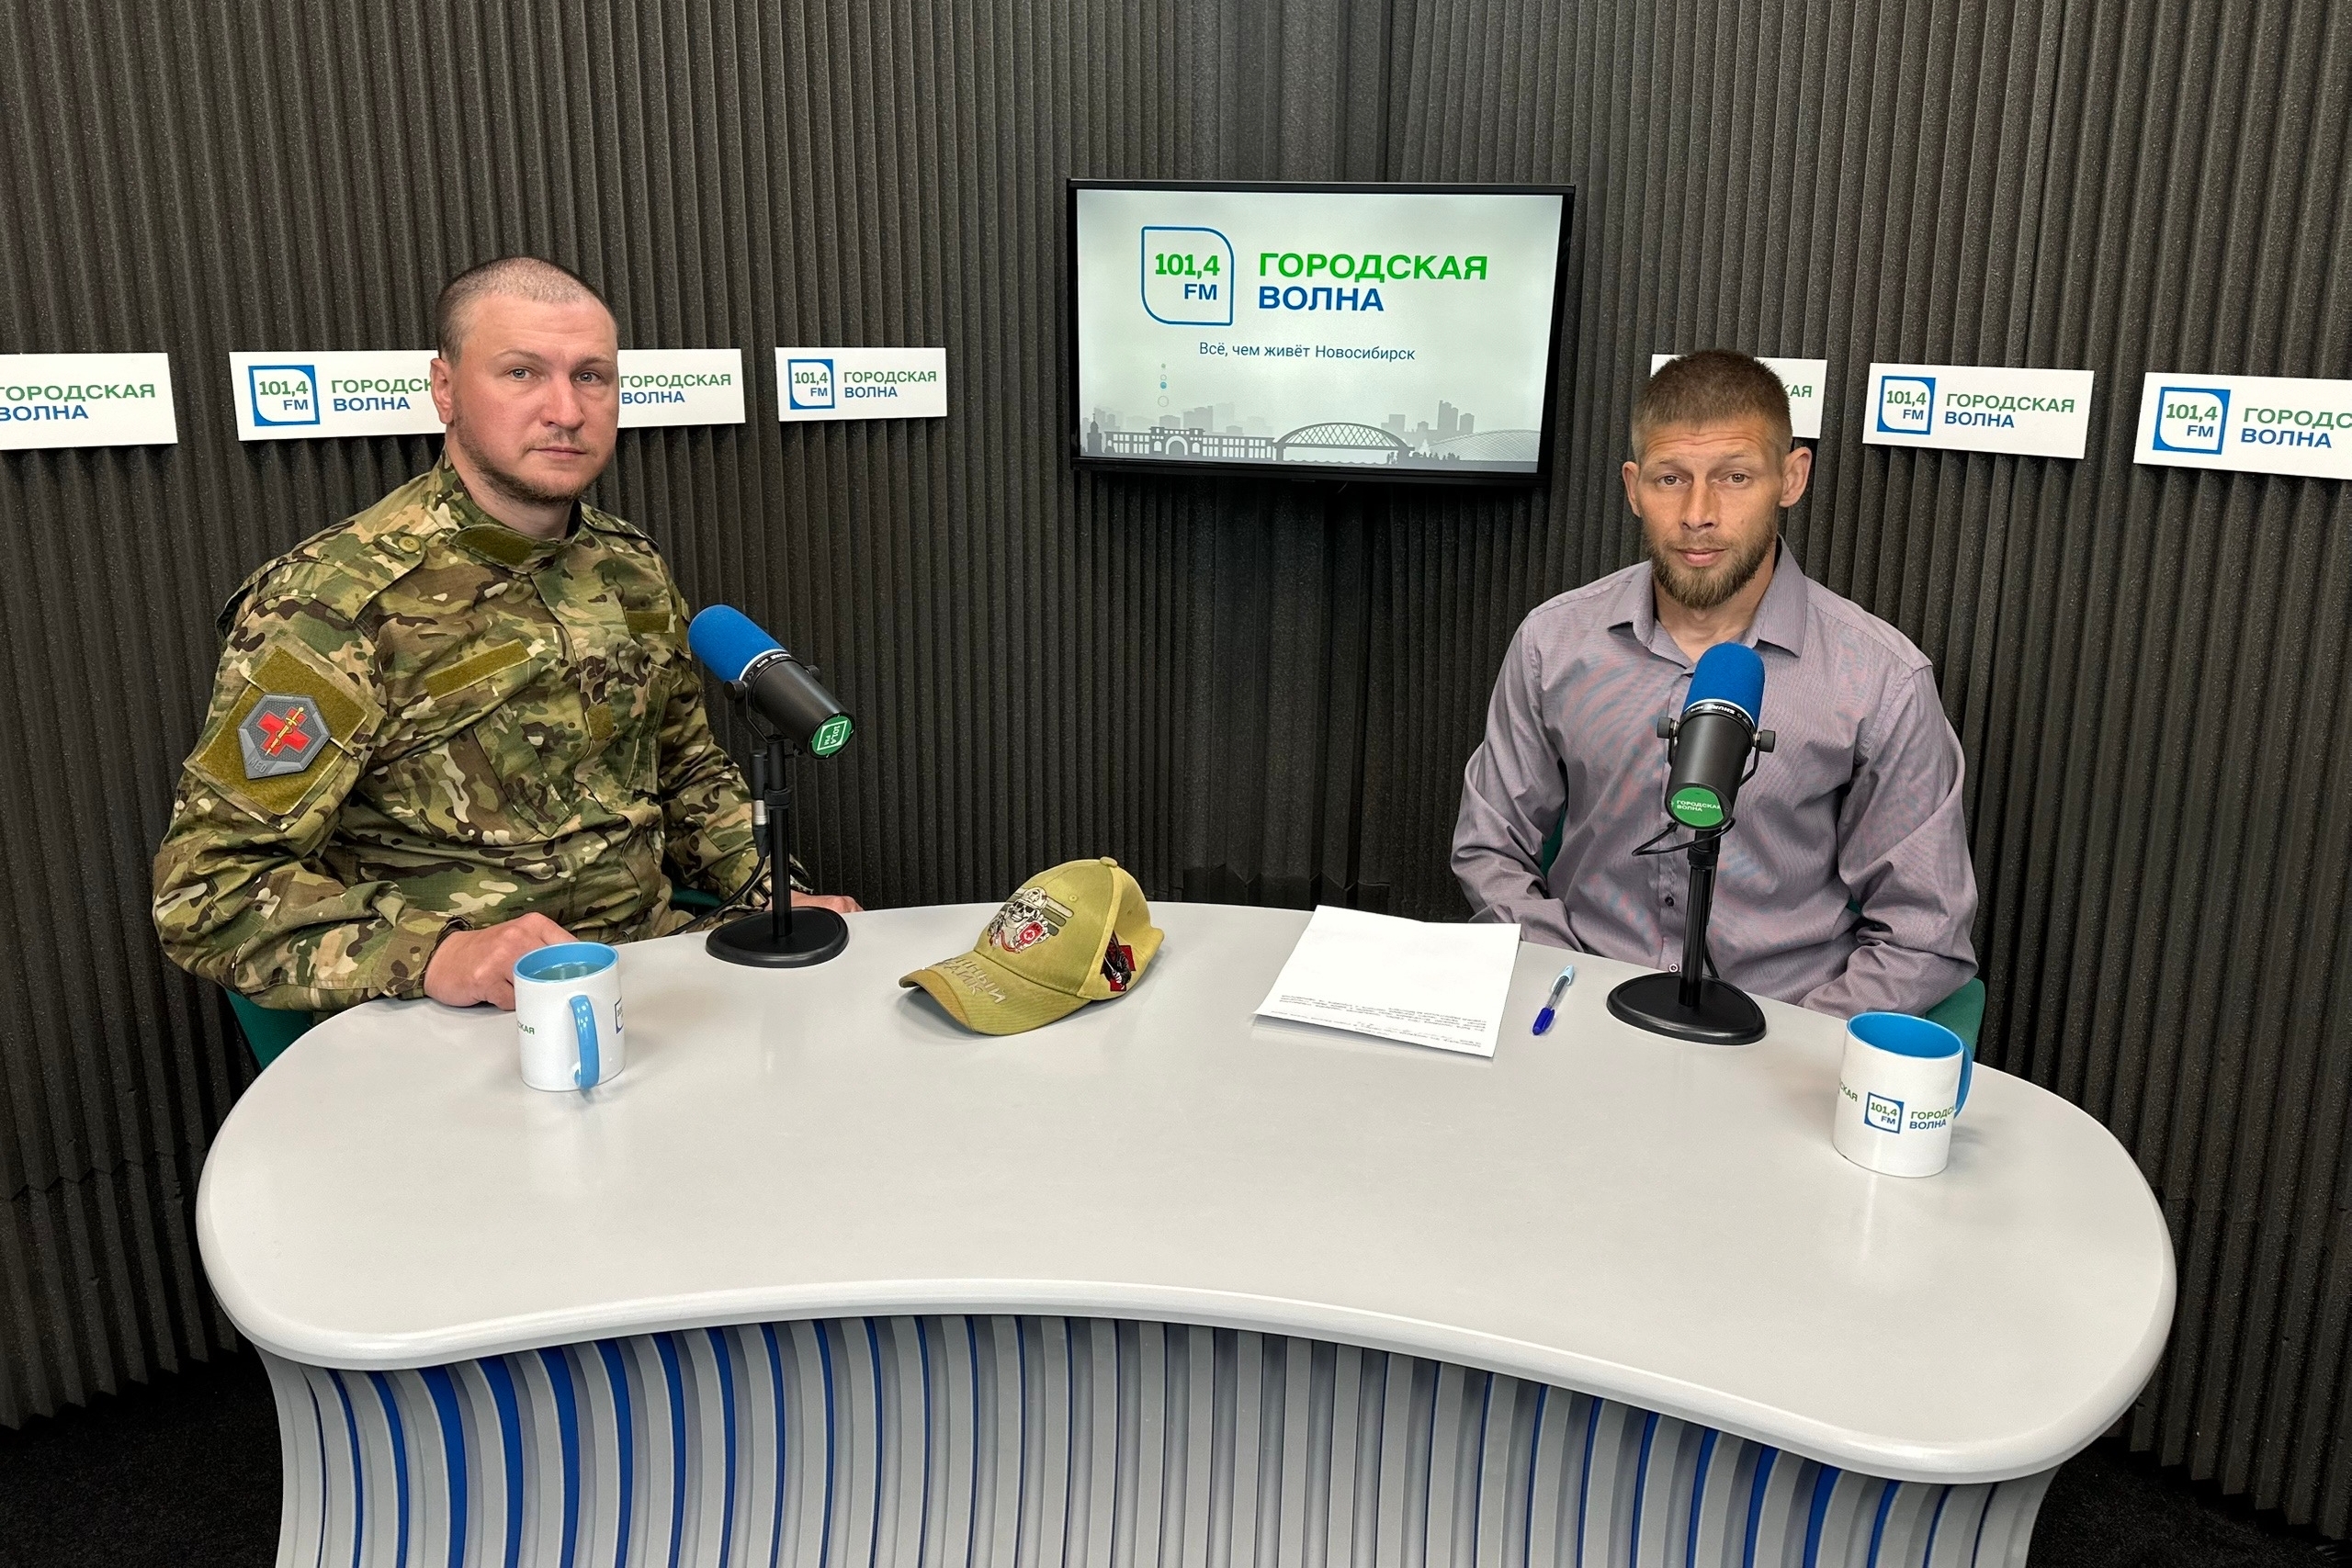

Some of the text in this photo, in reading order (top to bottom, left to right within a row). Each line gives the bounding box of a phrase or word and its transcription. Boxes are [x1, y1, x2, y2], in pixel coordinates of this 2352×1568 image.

[1155, 253, 1220, 279] 101,4
[1259, 253, 1488, 283] ГОРОДСКАЯ
[1183, 283, 1217, 300] FM
[1259, 286, 1385, 311] ВОЛНА
[1199, 342, 1416, 362] Всё, чем живёт Новосибирск
[619, 373, 731, 389] ГОРОДСКАЯ
[794, 371, 828, 386] 101,4
[843, 370, 937, 385] ГОРОДСКАЯ
[0, 383, 156, 402] ОРОДСКАЯ
[258, 380, 309, 397] 101,4
[331, 378, 432, 395] ГОРОДСК
[809, 387, 828, 397] FM
[844, 386, 899, 399] ВОЛНА
[283, 399, 309, 411] FM
[333, 396, 411, 412] ВОЛНА
[621, 390, 685, 405] ВОЛНА
[1886, 390, 1927, 408] 101,4
[1945, 393, 2075, 414] ГОРОДСКАЯ
[1903, 409, 1925, 421] FM
[1944, 411, 2016, 429] ВОЛНА
[2165, 403, 2218, 423] 101,4
[2243, 407, 2352, 431] ГОРОДС
[2187, 424, 2214, 438] FM
[2240, 427, 2333, 448] ВОЛНА
[1871, 1102, 1897, 1116] 101,4
[1881, 1115, 1895, 1125] FM
[1909, 1119, 1947, 1130] ВОЛНА
